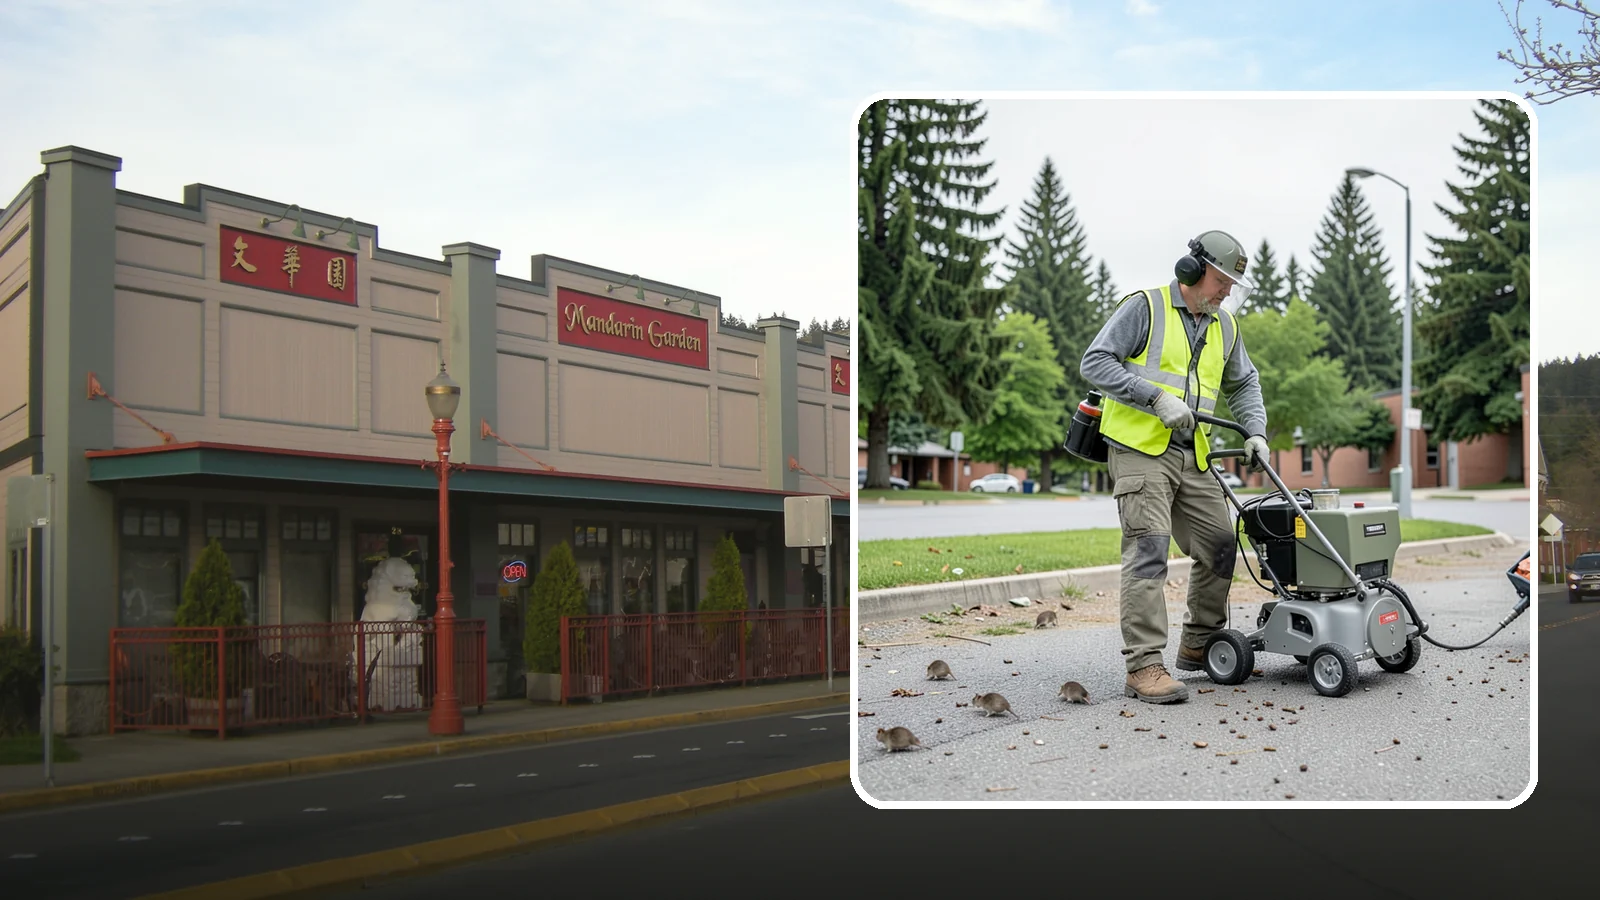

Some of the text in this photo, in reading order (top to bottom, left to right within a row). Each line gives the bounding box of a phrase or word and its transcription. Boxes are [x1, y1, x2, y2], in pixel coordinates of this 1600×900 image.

[231, 235, 347, 291] 文華園
[564, 302, 702, 352] Mandarin Garden
[503, 565, 527, 578] OPEN
